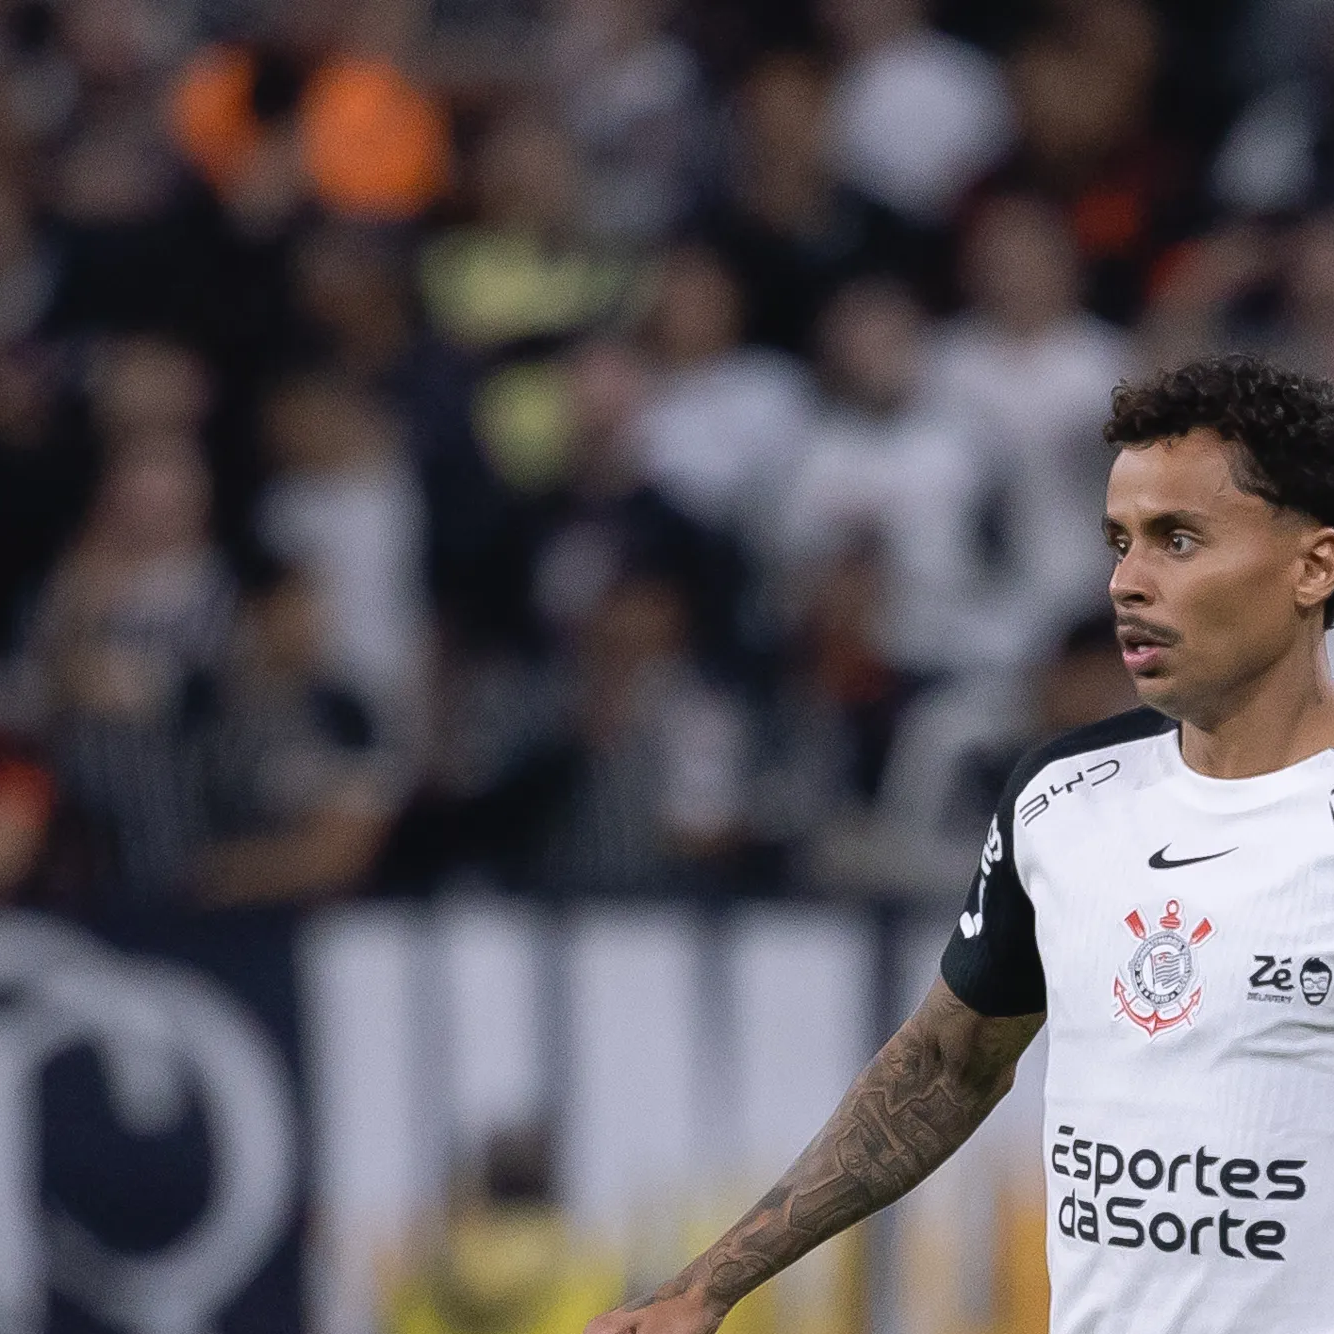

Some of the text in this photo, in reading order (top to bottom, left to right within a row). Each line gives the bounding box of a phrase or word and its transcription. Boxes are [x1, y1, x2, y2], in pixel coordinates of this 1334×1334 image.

[1018, 759, 1120, 827] BYD
[1249, 954, 1295, 991] Zé
[1051, 1124, 1308, 1201] Esportes
